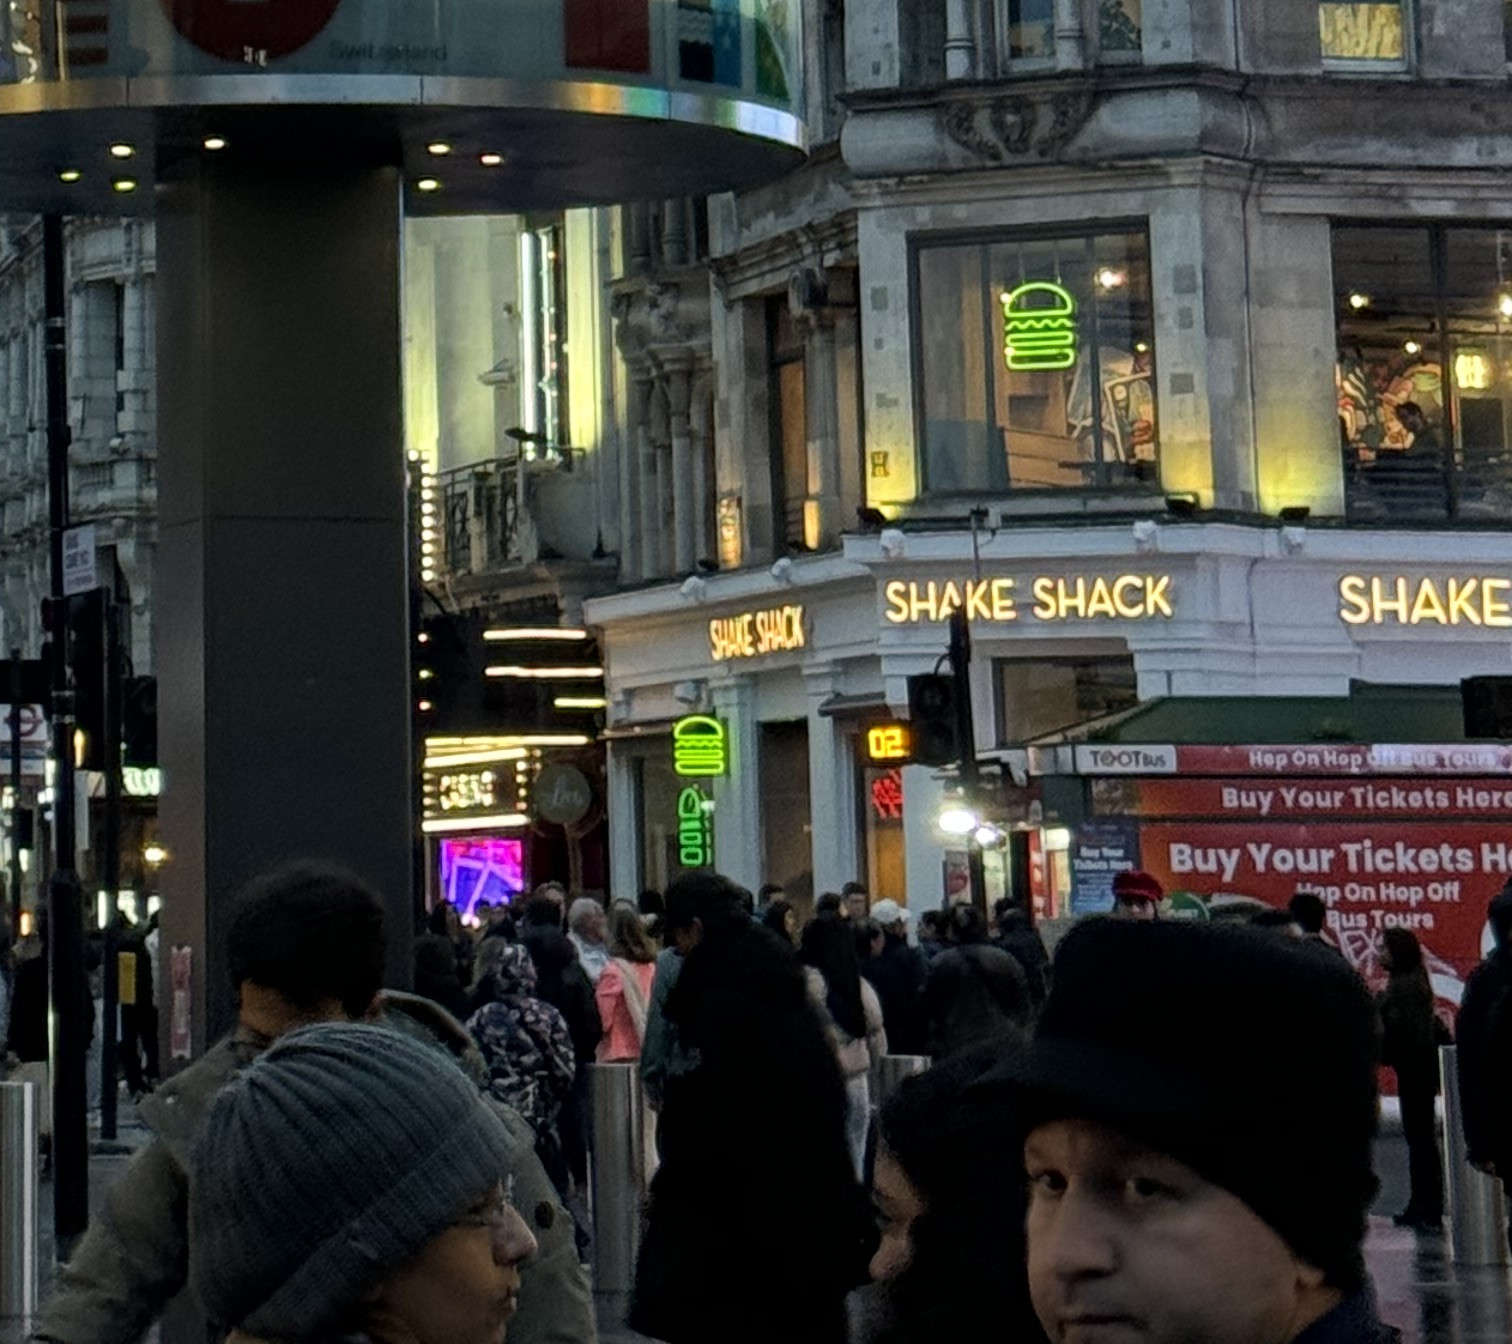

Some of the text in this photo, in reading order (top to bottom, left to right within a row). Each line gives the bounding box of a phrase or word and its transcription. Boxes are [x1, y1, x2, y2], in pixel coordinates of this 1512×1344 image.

[885, 575, 1174, 623] SHAKE SHACK
[1340, 574, 1512, 627] SHAKE
[710, 604, 805, 662] SHAKE SHACK
[868, 726, 907, 759] 02
[1249, 749, 1288, 771] Hop
[1292, 749, 1320, 767] On
[1323, 749, 1363, 773] Hop
[1221, 787, 1273, 815] Buy
[1279, 787, 1344, 809] Your
[1351, 785, 1450, 809] Tickets
[1170, 842, 1241, 883] Buy
[1246, 843, 1336, 874] Your
[1340, 838, 1475, 874] Tickets
[1344, 882, 1377, 902] On
[1379, 881, 1424, 907] Hop
[1426, 880, 1461, 902] Off
[1325, 909, 1434, 929] Bus Tours
